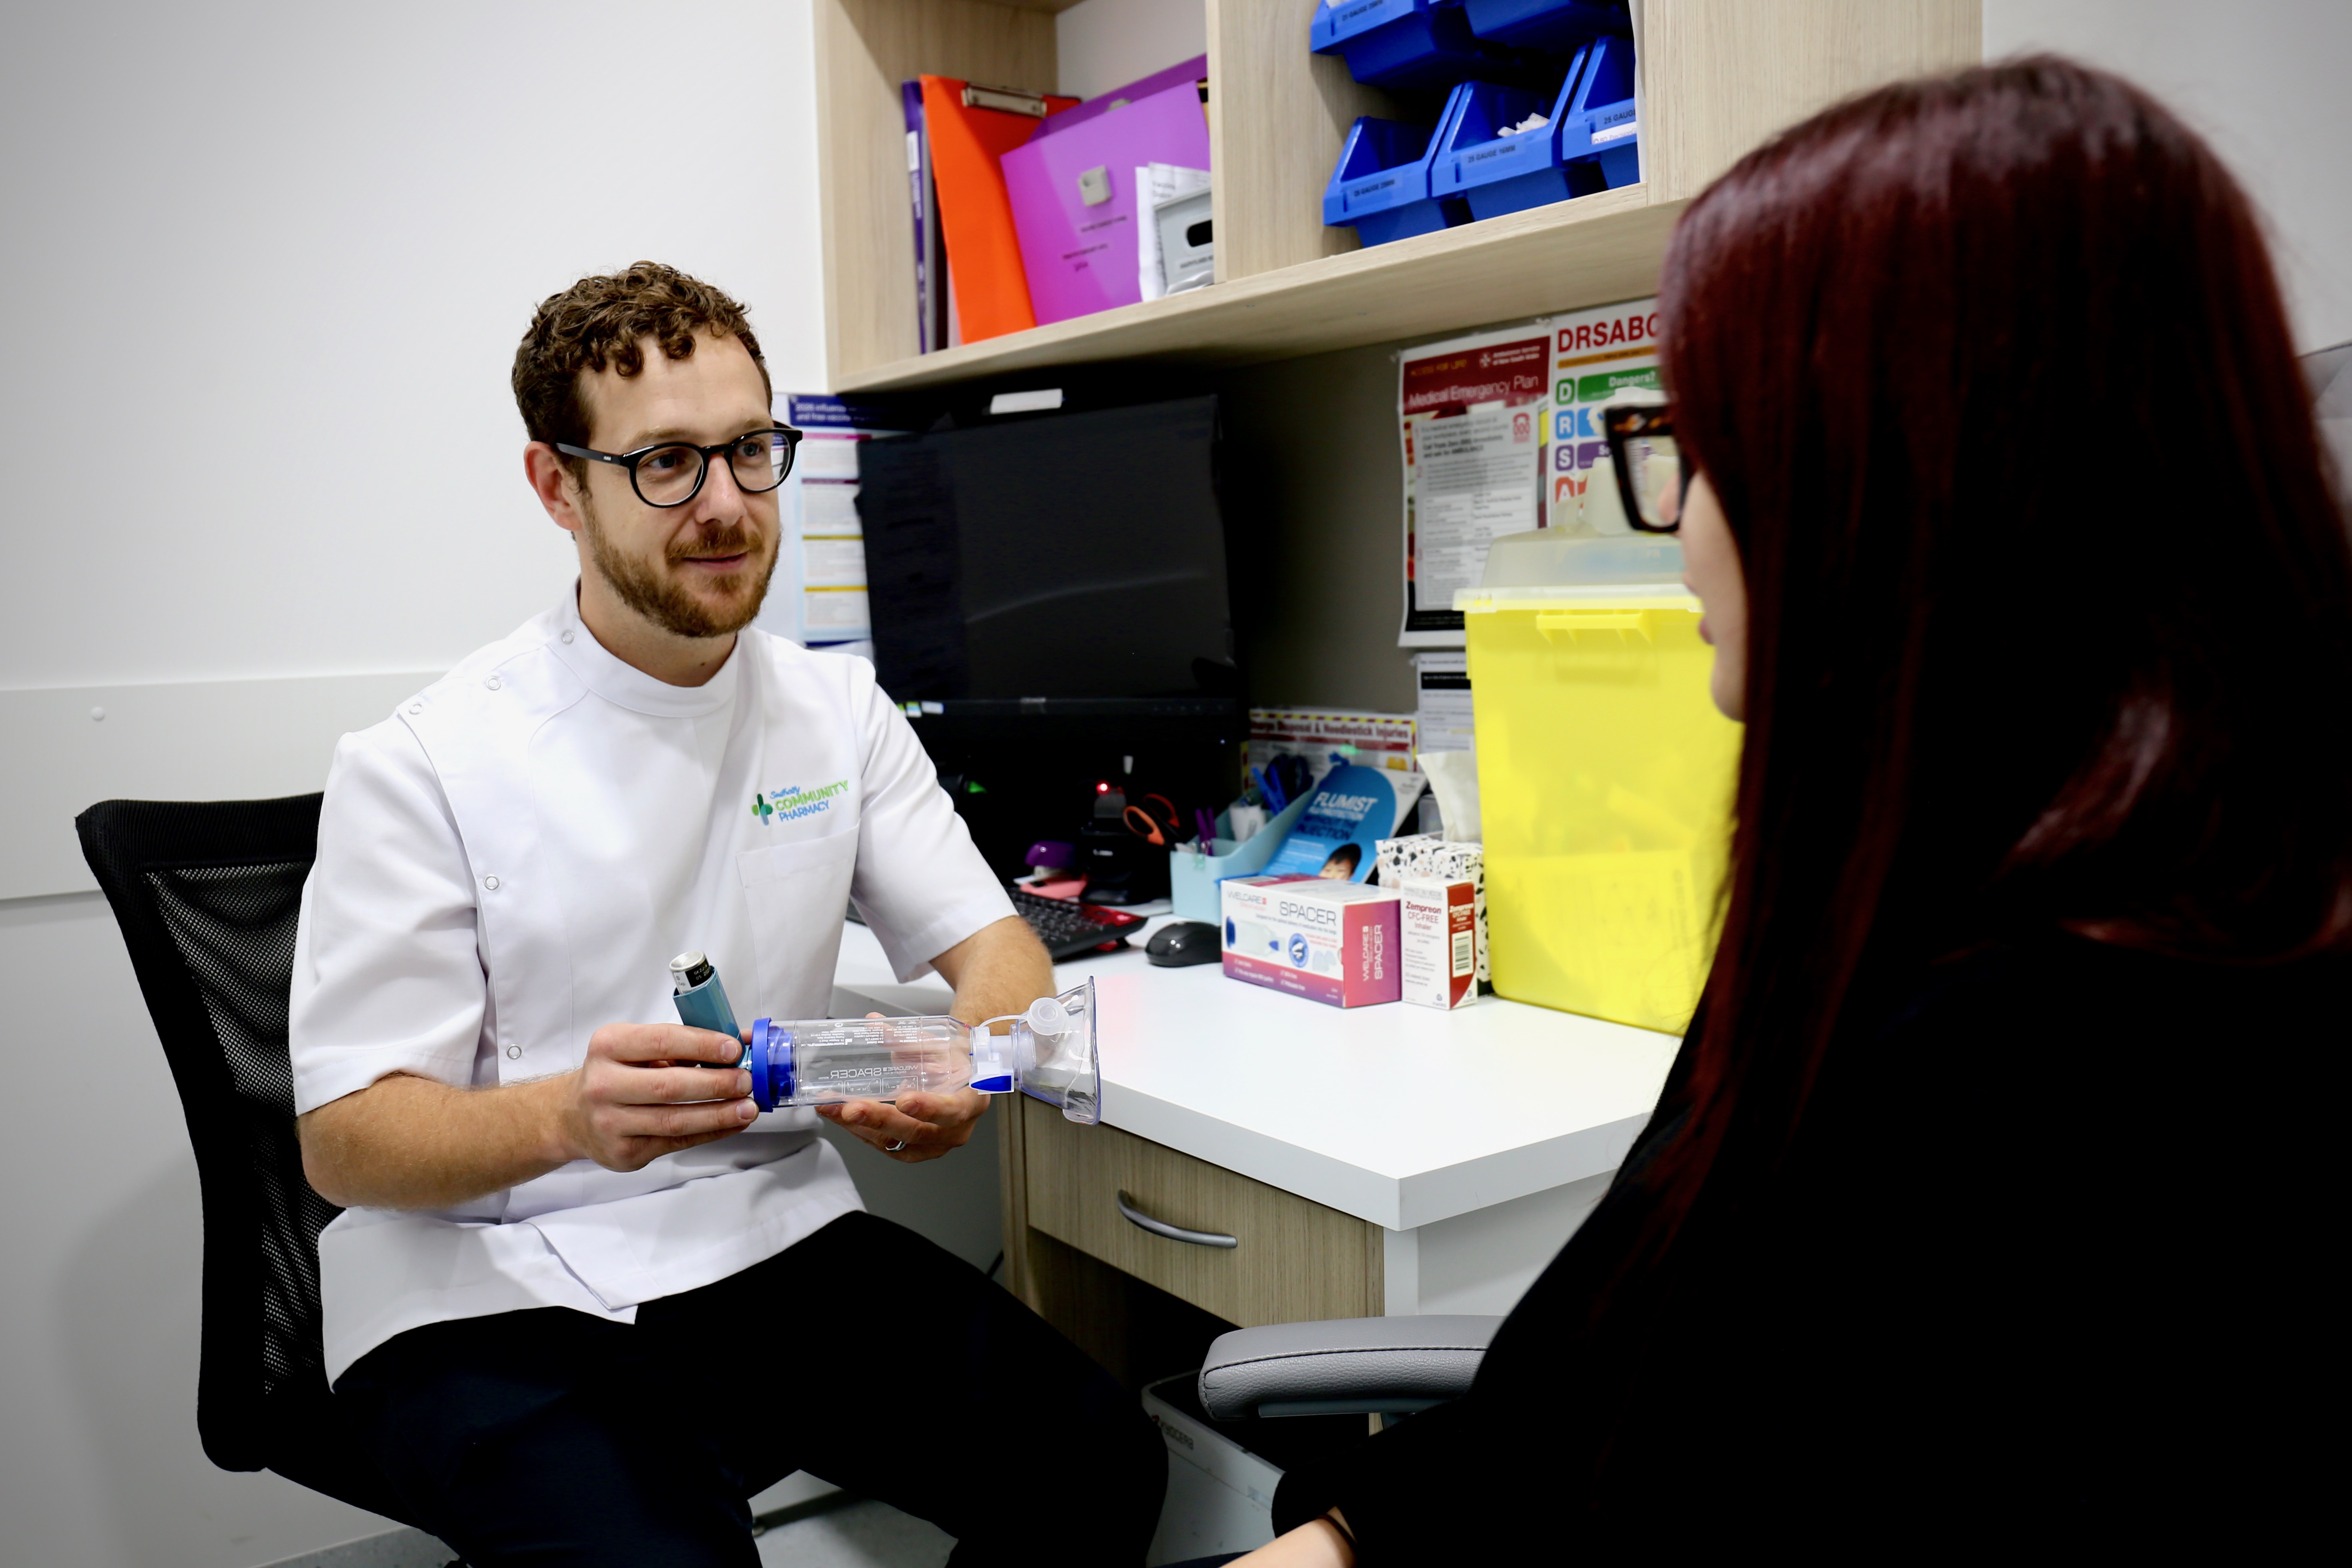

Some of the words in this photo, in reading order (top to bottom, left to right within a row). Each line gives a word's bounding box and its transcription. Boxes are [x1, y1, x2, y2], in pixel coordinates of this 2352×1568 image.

[1476, 149, 1497, 160] GAUGE
[1609, 371, 1656, 387] Dangers?
[1409, 388, 1449, 407] Medical
[1451, 381, 1510, 400] Emergency
[1513, 375, 1539, 389] Plan
[1323, 723, 1373, 735] Needlestick
[1375, 726, 1409, 740] Injuries
[775, 780, 848, 810] COMMUNITY
[1314, 792, 1379, 812] FLUMIST
[779, 800, 829, 821] PHARMACY
[1228, 891, 1262, 904] WELCARE
[1280, 901, 1337, 926] SPACER
[1406, 901, 1442, 915] Zempreon
[1449, 903, 1474, 913] Zempreon
[1408, 911, 1439, 924] CFC-FREE
[1415, 922, 1432, 930] Inhaler
